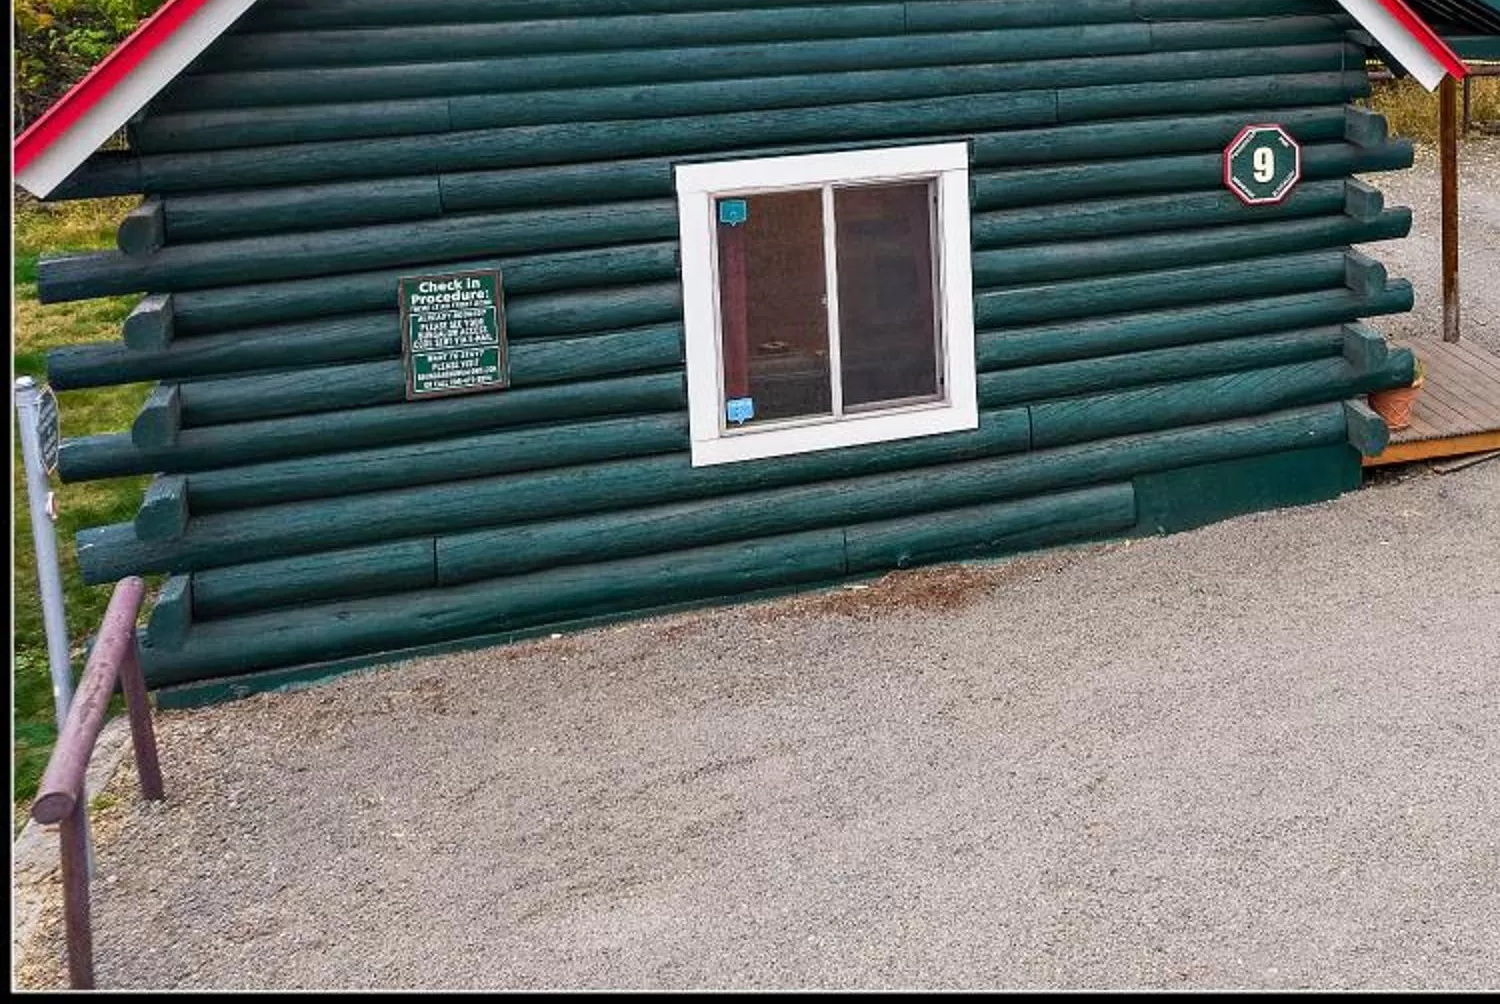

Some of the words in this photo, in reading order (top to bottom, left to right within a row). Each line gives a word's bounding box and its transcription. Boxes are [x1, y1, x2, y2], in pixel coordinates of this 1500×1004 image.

[1253, 147, 1275, 183] 9
[419, 279, 463, 293] Check
[467, 277, 481, 289] in
[411, 290, 489, 305] Procedure:
